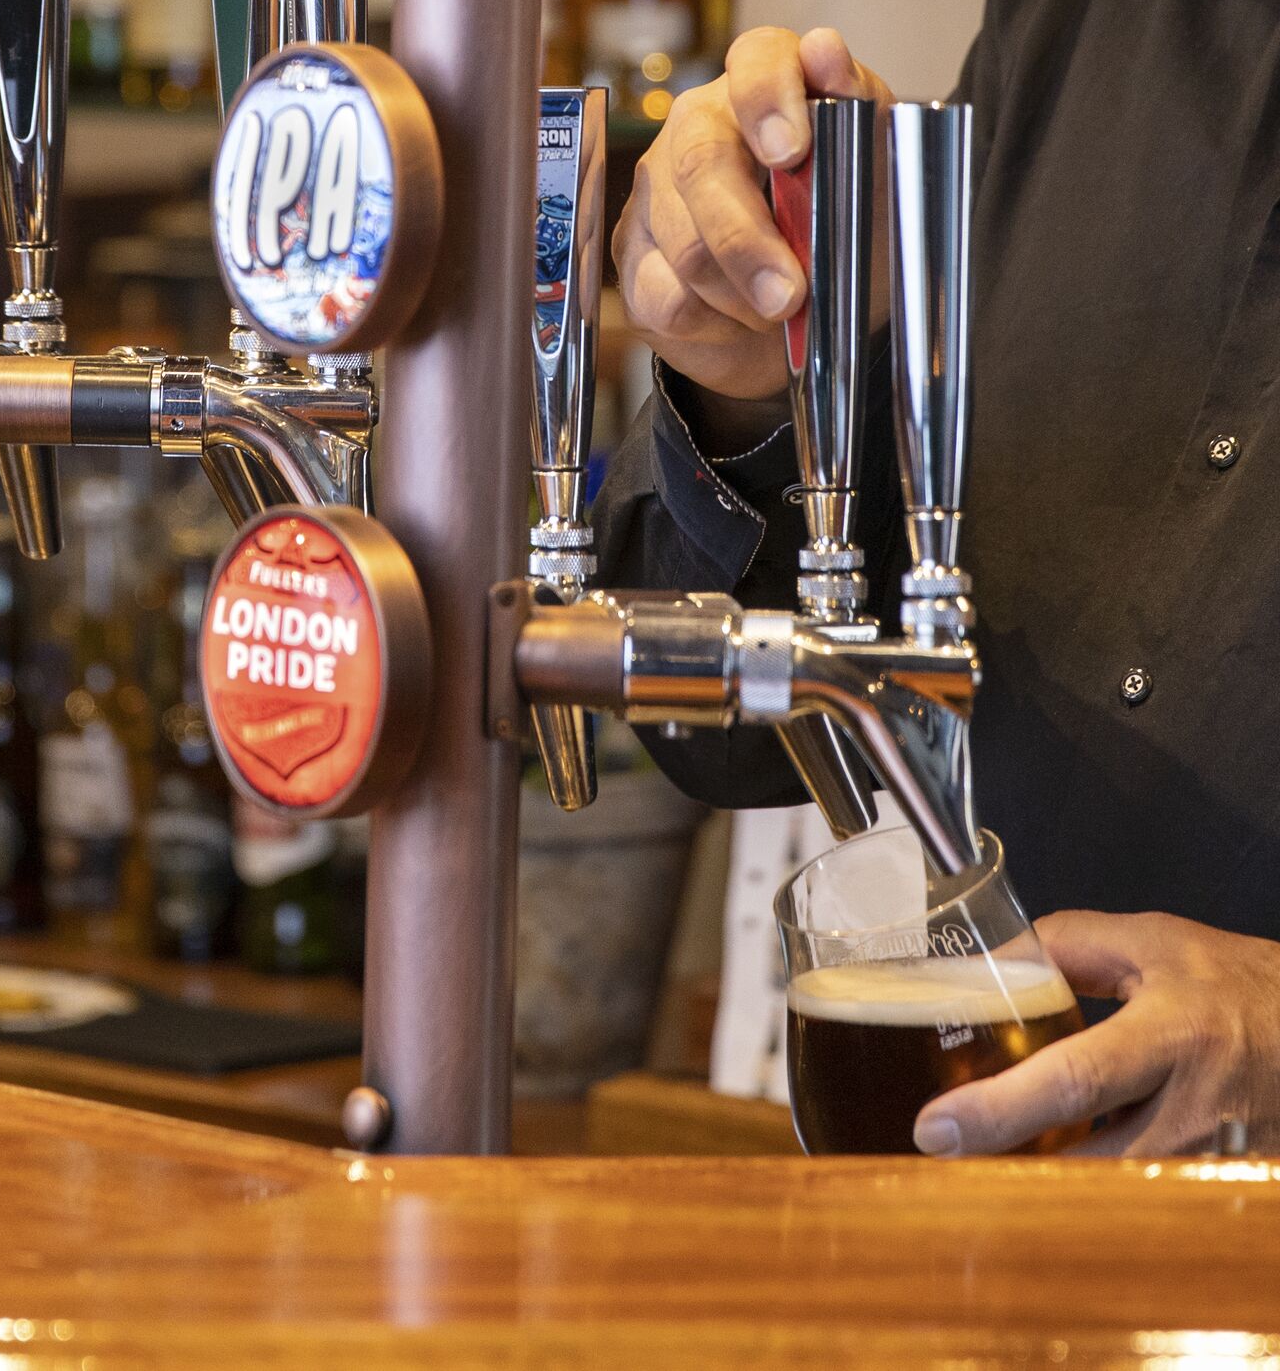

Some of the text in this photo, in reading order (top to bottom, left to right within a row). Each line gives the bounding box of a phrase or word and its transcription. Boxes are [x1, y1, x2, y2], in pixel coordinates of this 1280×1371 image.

[230, 104, 360, 270] IPA
[212, 595, 358, 656] LONDON
[226, 640, 337, 693] PRIDE
